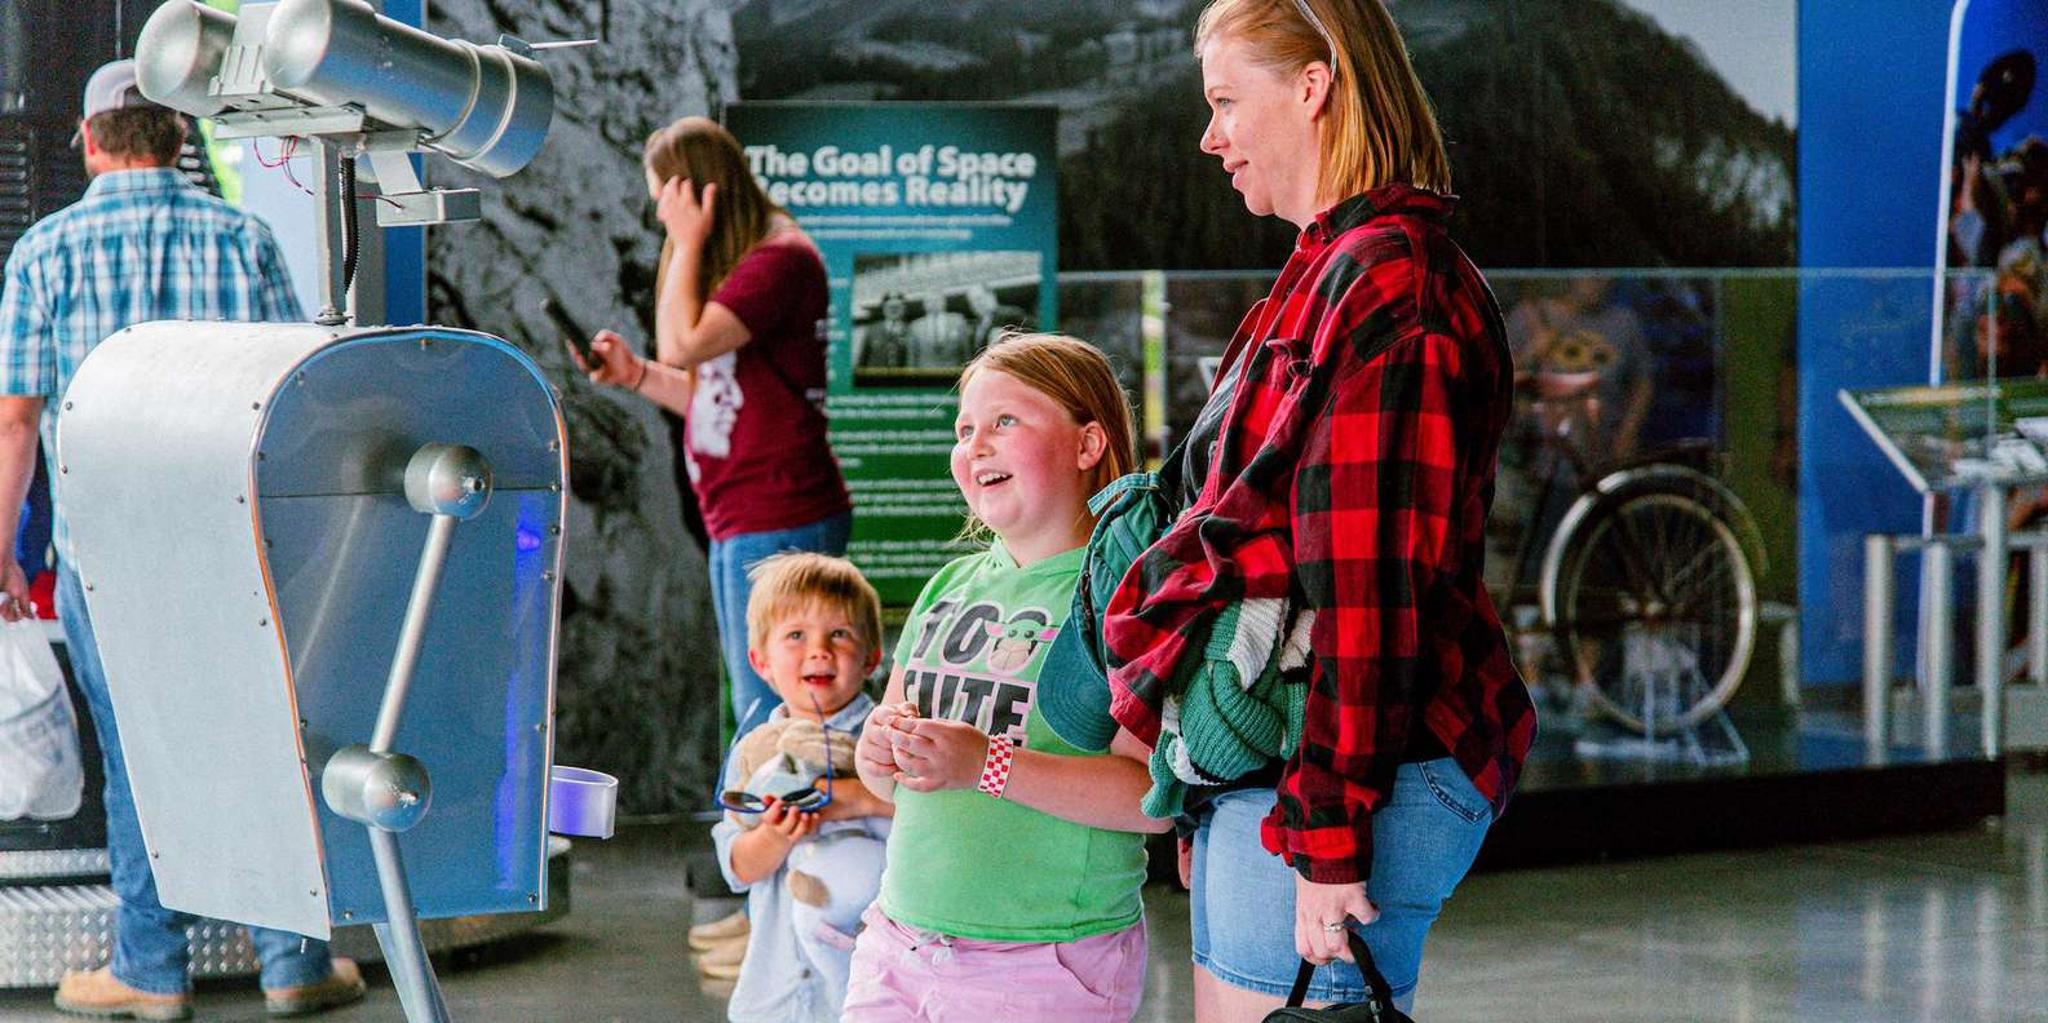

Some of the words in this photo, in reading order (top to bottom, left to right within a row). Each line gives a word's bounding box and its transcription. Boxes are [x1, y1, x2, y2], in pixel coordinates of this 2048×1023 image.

[744, 145, 809, 177] The
[813, 145, 892, 177] Goal
[896, 145, 935, 177] of
[937, 145, 1037, 181] Space
[904, 176, 1028, 212] Reality
